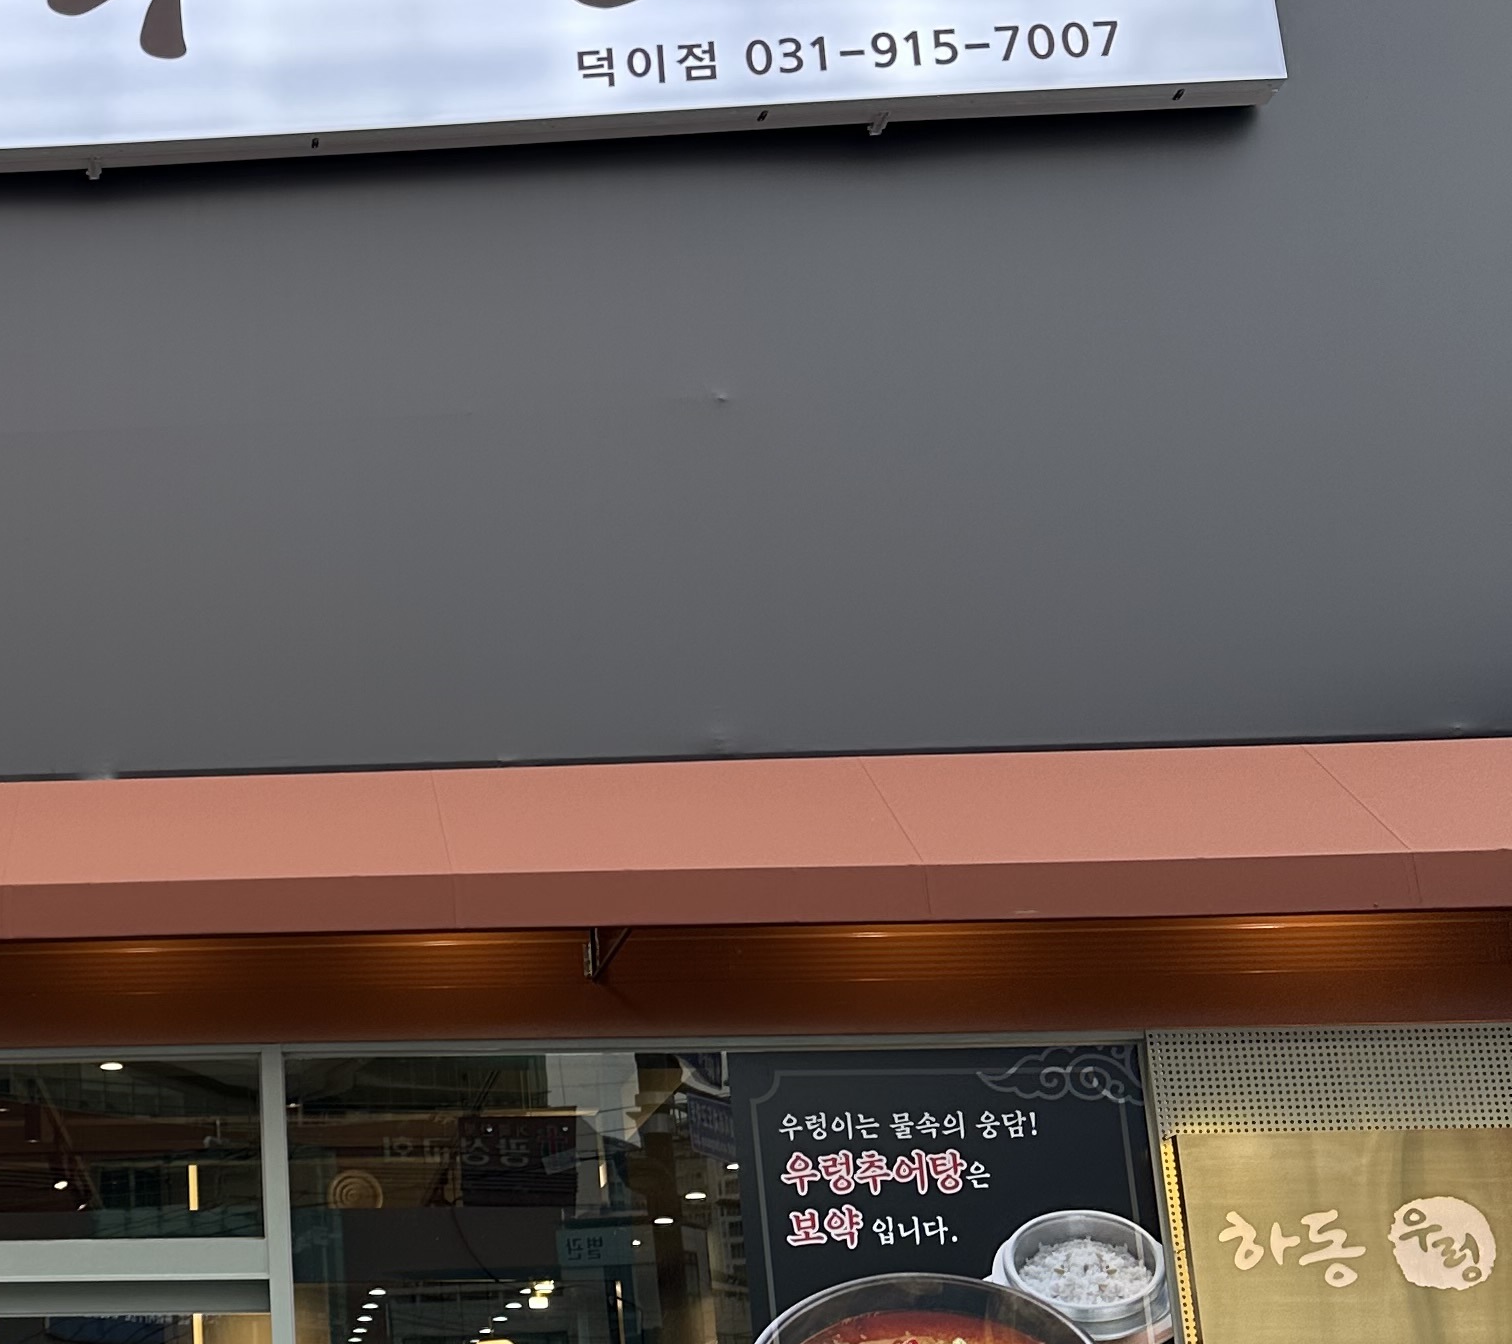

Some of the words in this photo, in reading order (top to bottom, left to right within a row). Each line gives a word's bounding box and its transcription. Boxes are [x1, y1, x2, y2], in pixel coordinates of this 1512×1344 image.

[576, 41, 720, 87] 덕이점
[745, 19, 1122, 78] 031-915-7007
[779, 1112, 880, 1142] 우렁이는
[889, 1111, 965, 1140] 물속의
[975, 1110, 1038, 1139] 웅담!
[780, 1148, 991, 1196] 우렁추어탕은
[786, 1204, 864, 1250] 보약
[872, 1216, 958, 1245] 입니다.
[1218, 1209, 1367, 1288] 하동
[1399, 1207, 1482, 1284] 우렁
